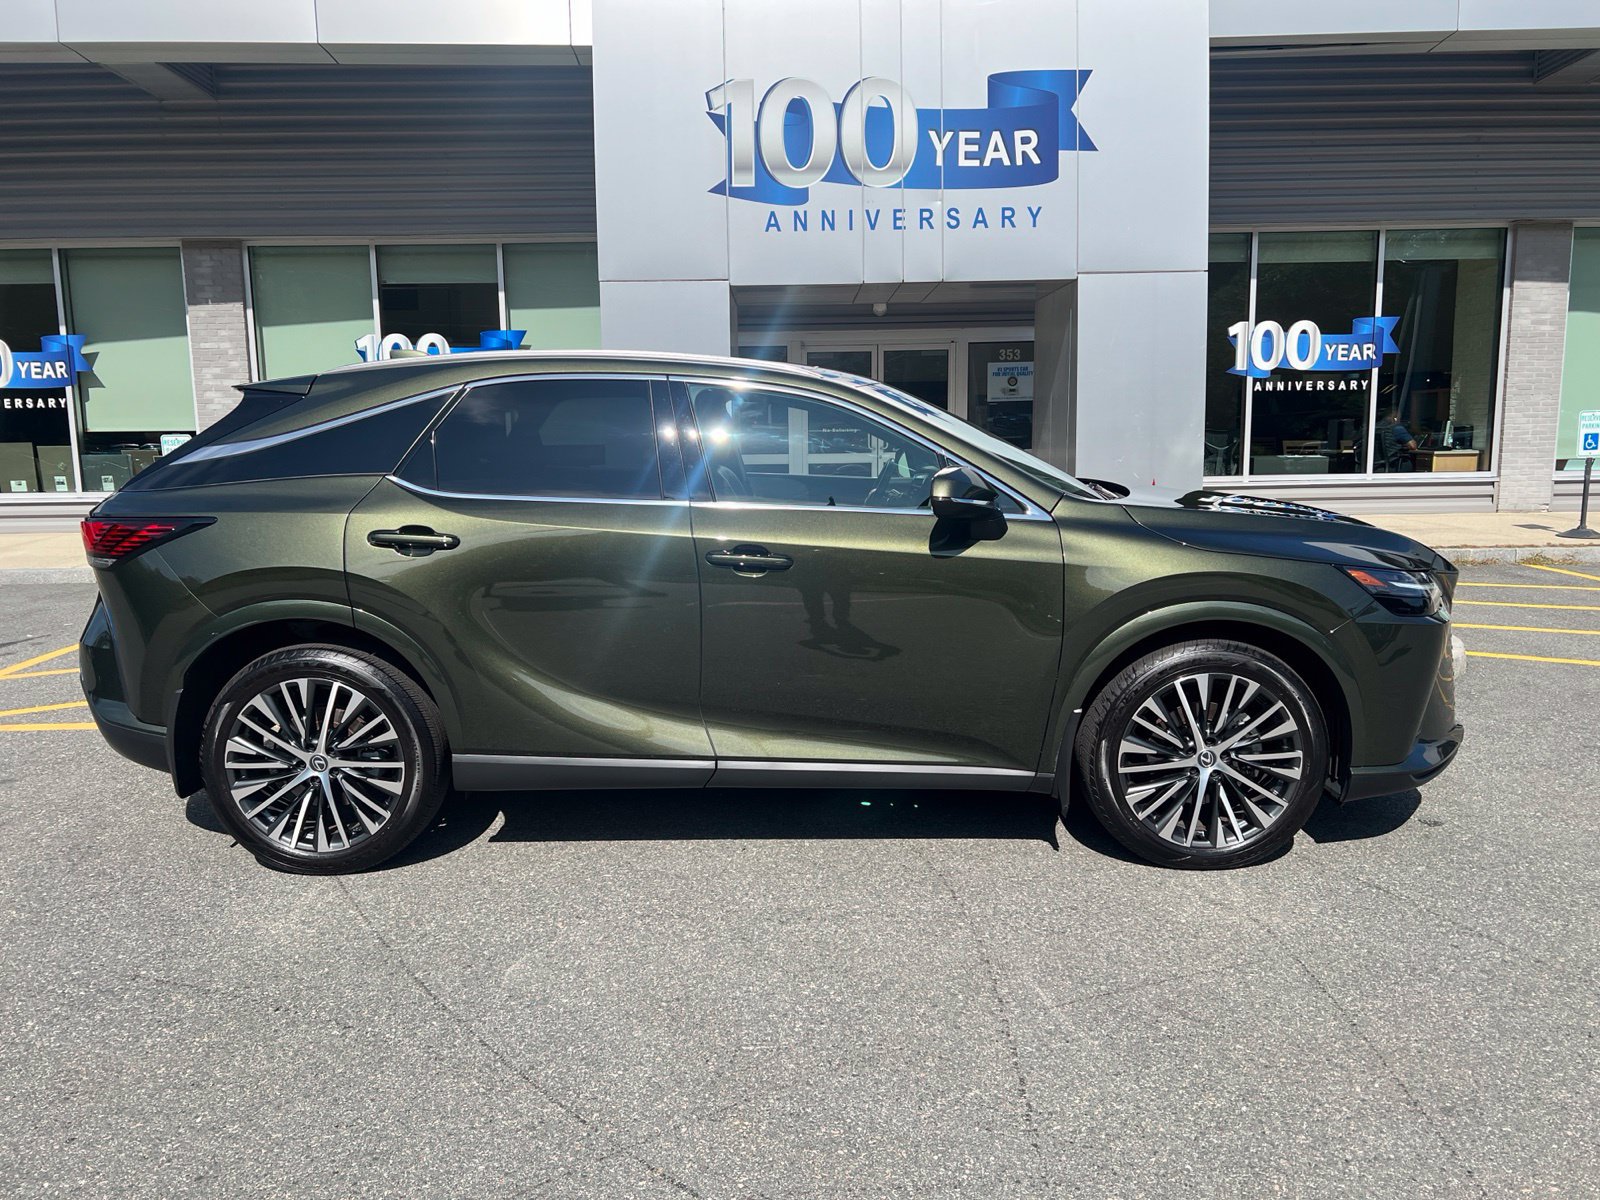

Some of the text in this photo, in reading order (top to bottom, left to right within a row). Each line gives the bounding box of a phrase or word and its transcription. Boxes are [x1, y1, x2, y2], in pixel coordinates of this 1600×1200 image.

[705, 76, 1042, 188] 100 YEAR
[764, 206, 1044, 233] ANNIVERSARY
[999, 349, 1021, 360] 353
[1227, 319, 1378, 371] 100 YEAR
[16, 361, 69, 379] YEAR
[1253, 379, 1369, 392] ANNIVERSARY
